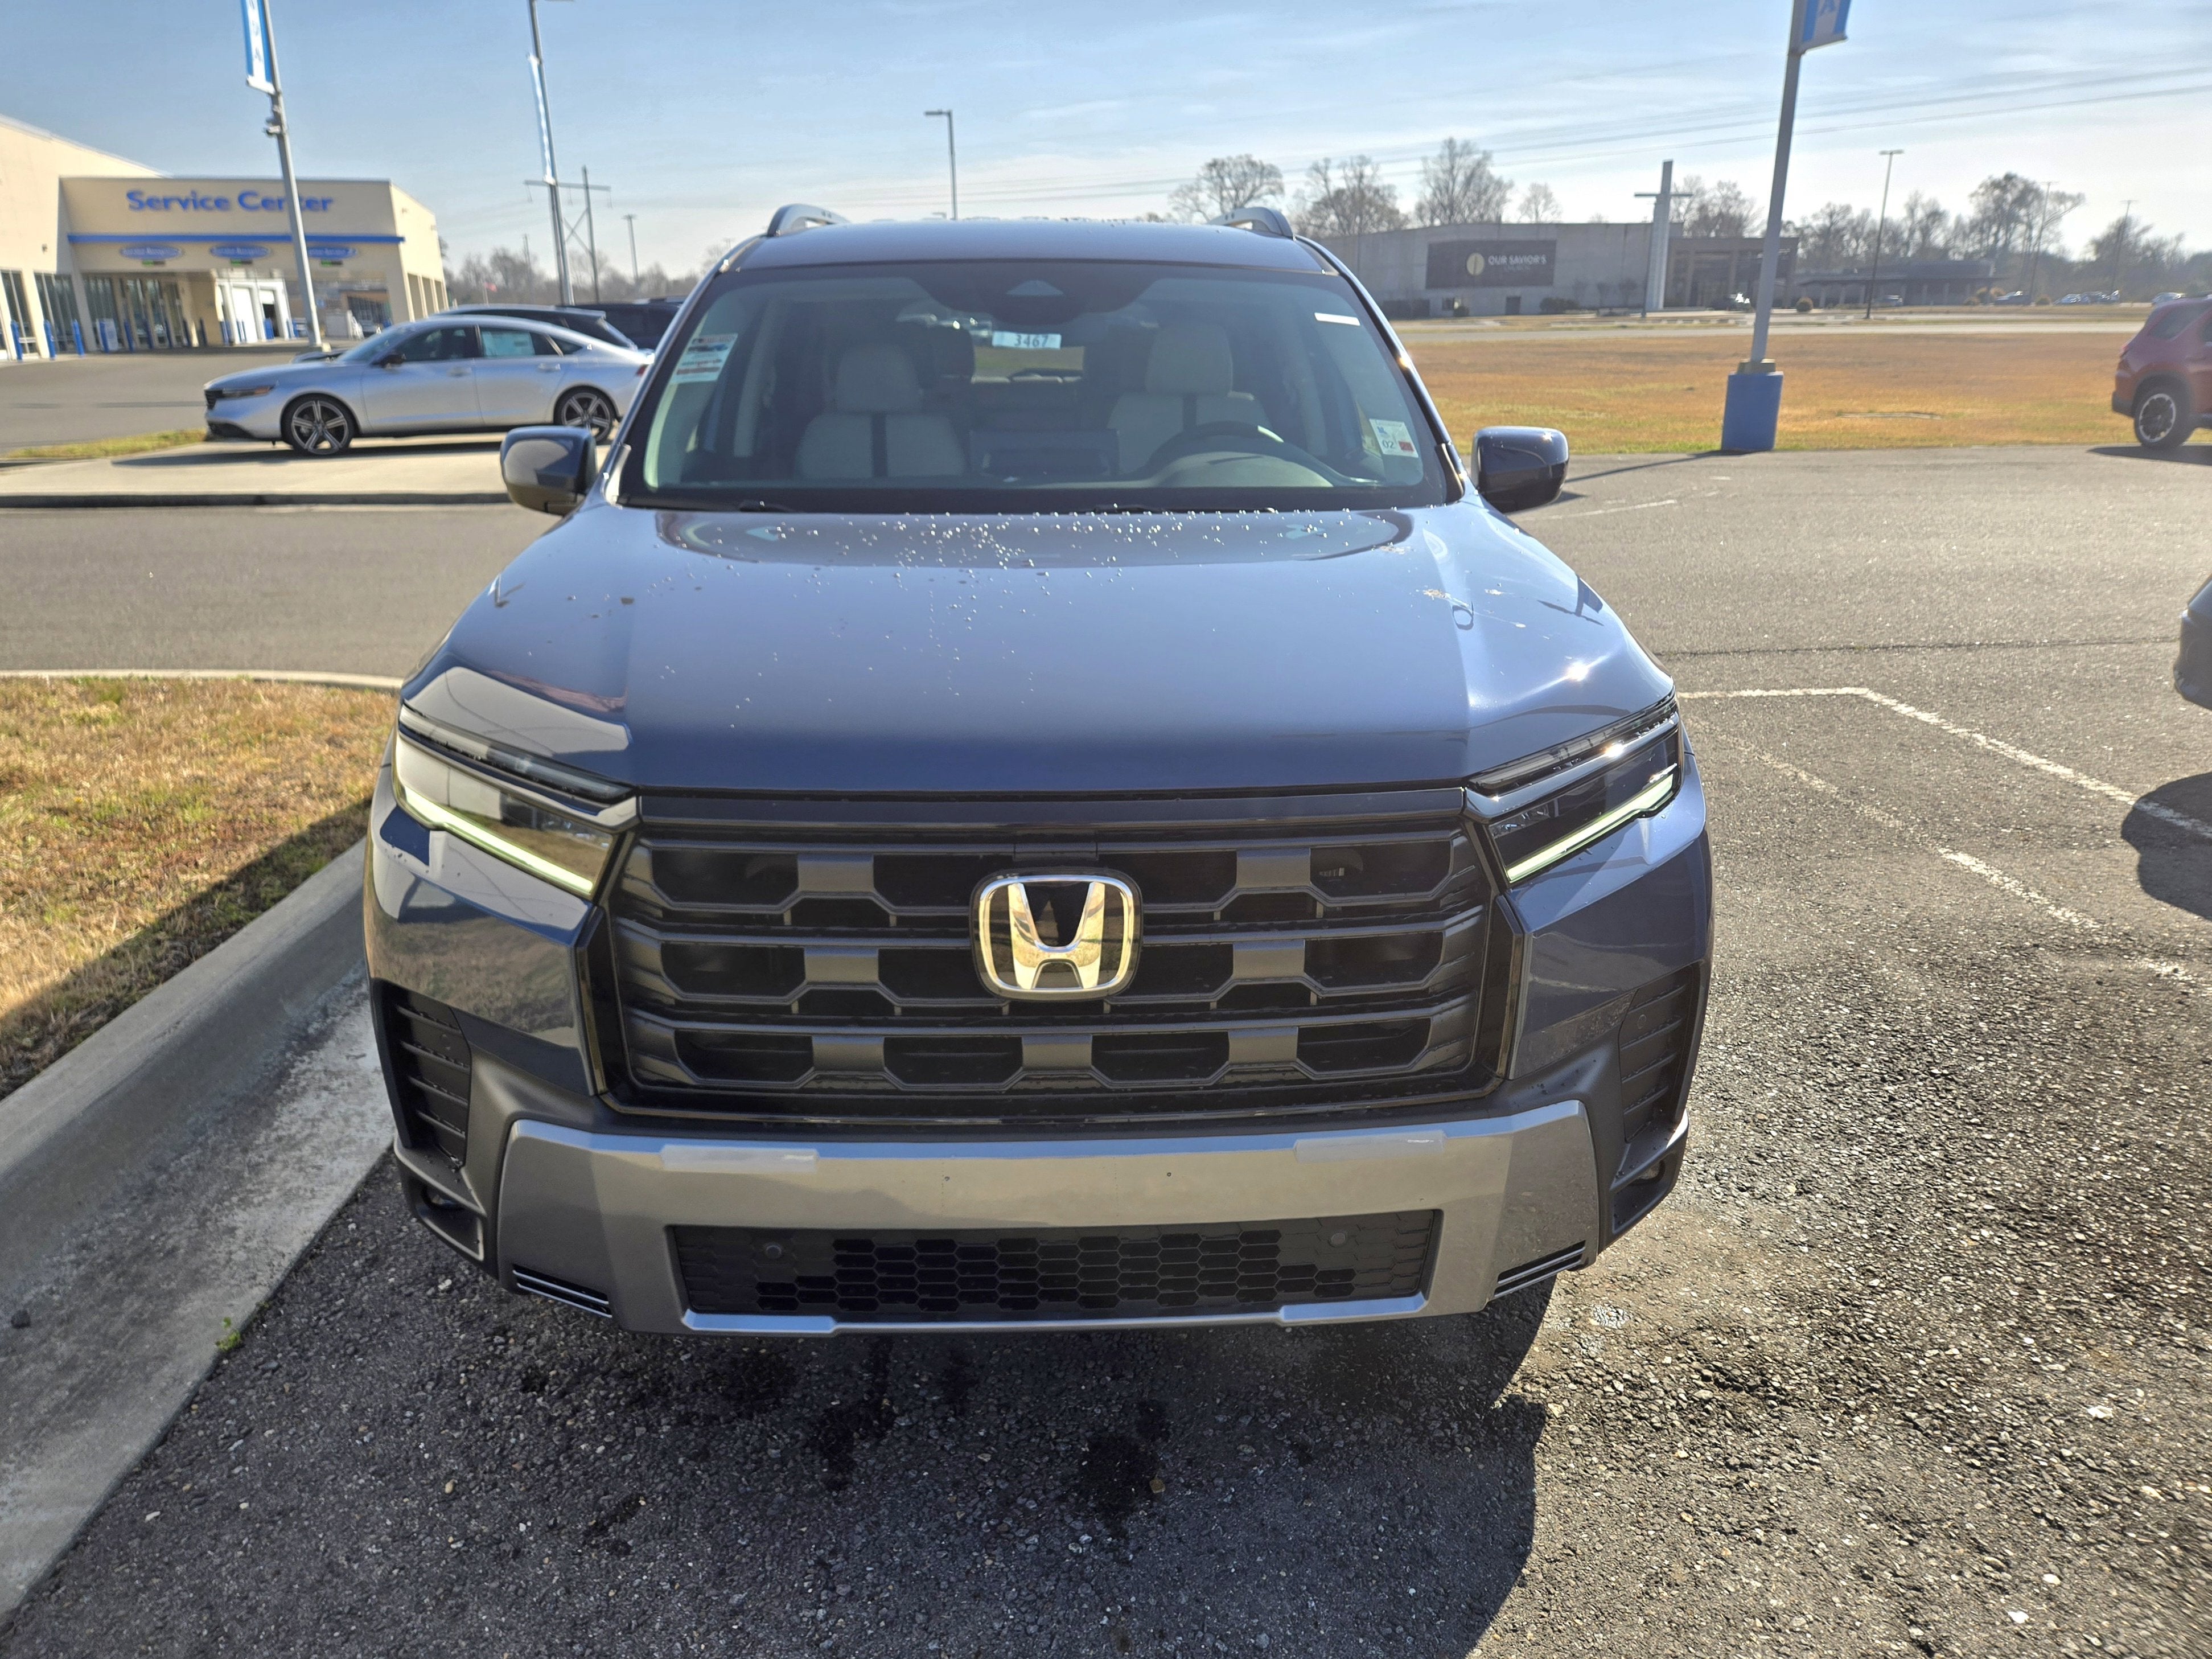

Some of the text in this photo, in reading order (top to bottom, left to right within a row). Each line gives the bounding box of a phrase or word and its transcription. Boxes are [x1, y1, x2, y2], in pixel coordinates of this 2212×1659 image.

[126, 189, 231, 212] Service
[1488, 254, 1507, 265] OUR
[1014, 334, 1049, 347] 3467
[1382, 439, 1396, 449] 02
